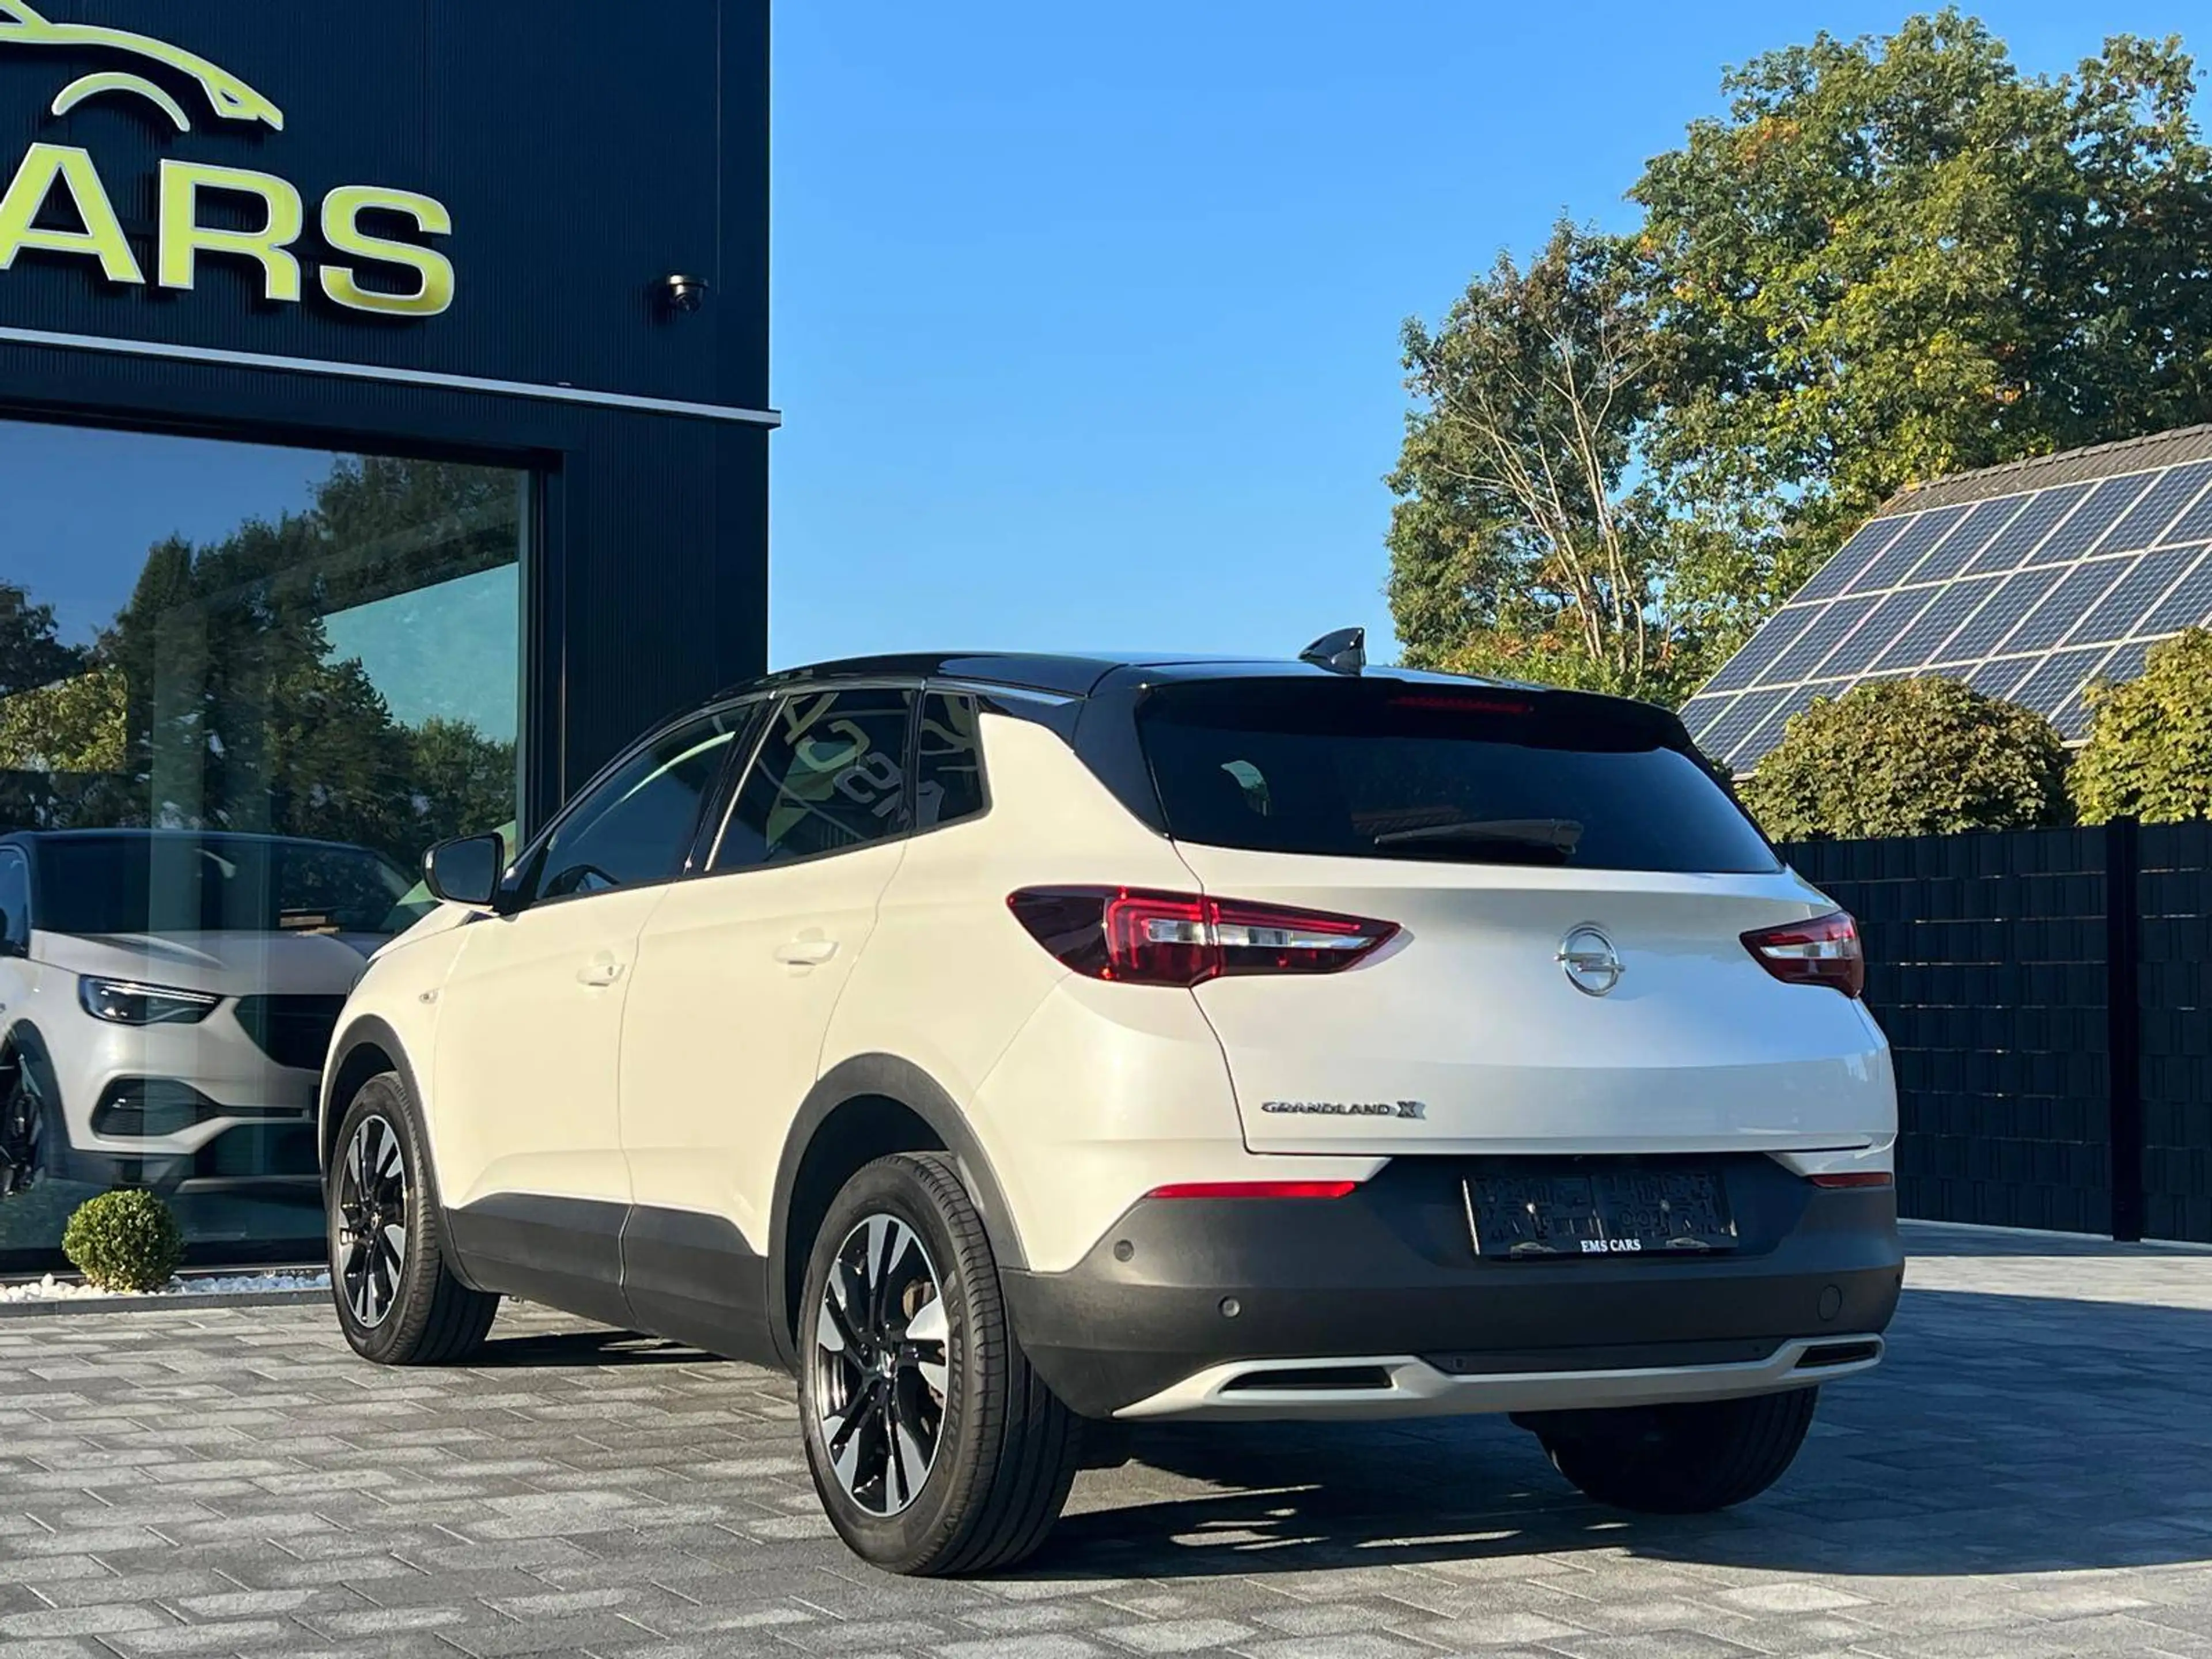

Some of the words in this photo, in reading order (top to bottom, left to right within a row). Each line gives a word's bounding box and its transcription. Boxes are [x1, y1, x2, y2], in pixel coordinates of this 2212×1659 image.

[0, 142, 454, 316] ARS
[1261, 1101, 1392, 1115] GRANDLAND
[1396, 1100, 1424, 1119] X
[1580, 1239, 1608, 1252] EMS
[1610, 1238, 1641, 1251] CARS
